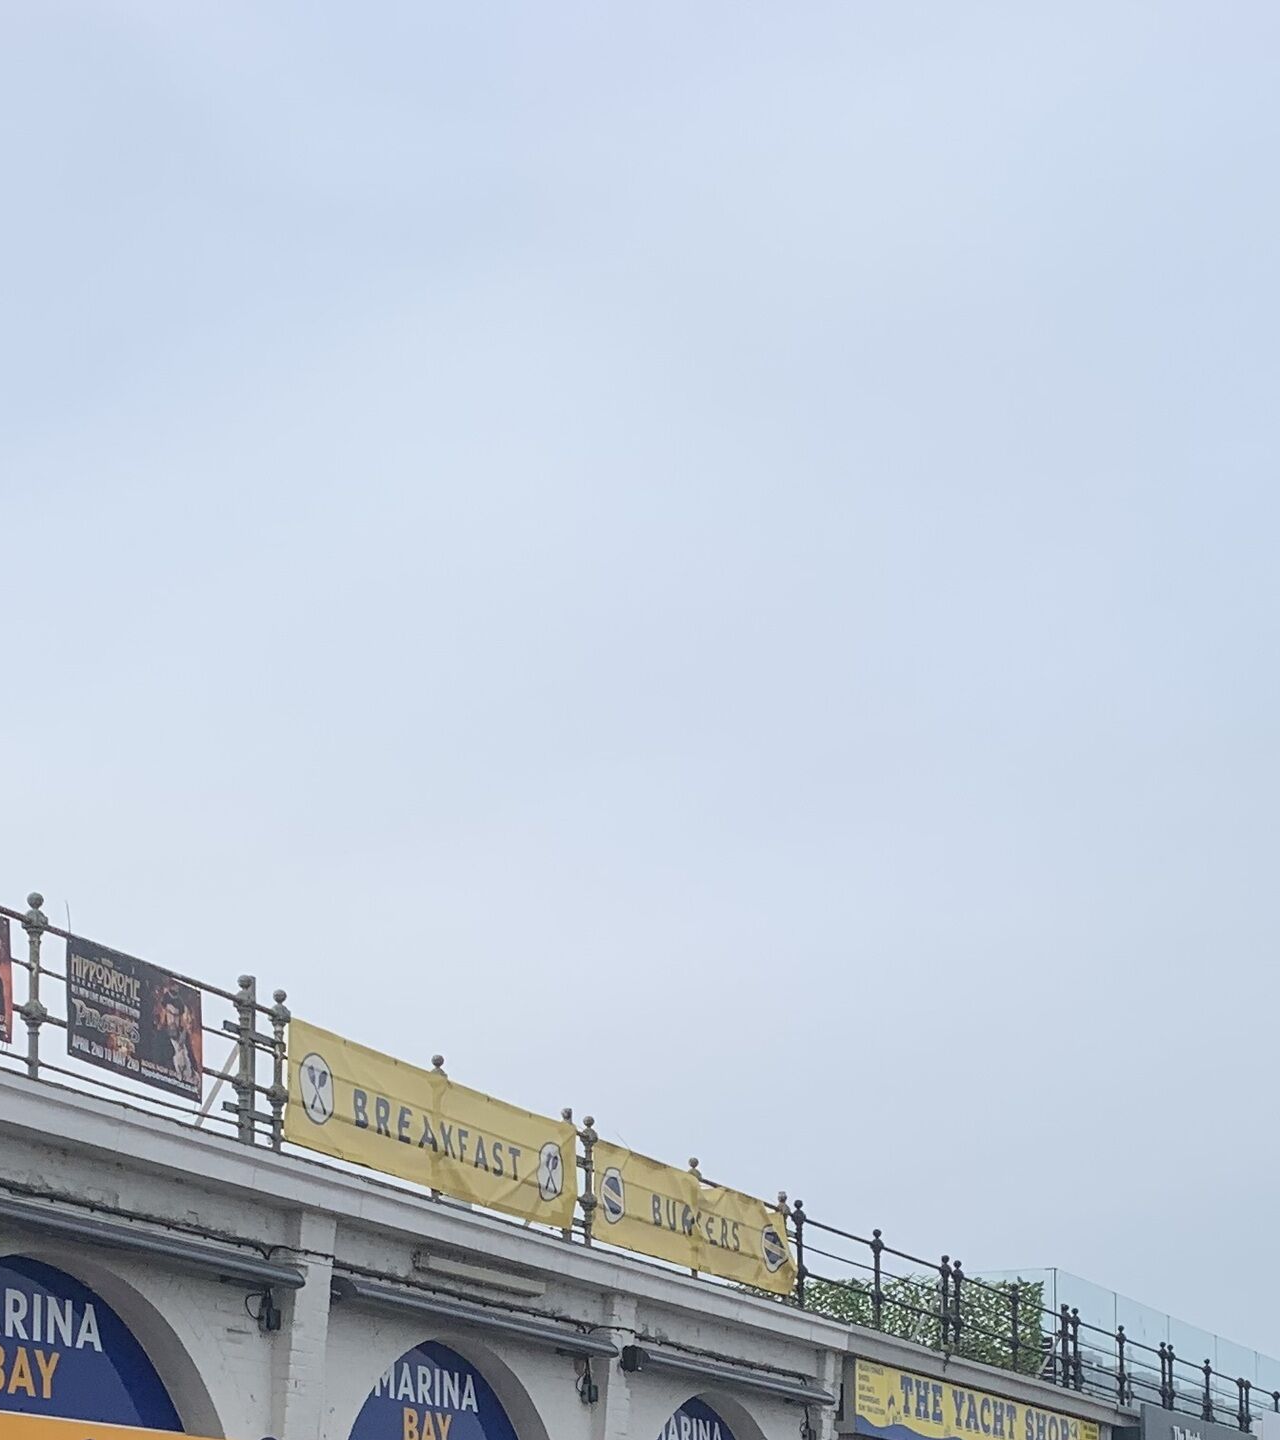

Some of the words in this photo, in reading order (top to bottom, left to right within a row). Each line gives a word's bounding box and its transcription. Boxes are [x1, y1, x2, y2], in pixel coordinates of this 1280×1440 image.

[71, 953, 141, 1002] HIPPODROME
[353, 1087, 521, 1181] BREAKFAST
[375, 1361, 479, 1414] MARINA
[900, 1375, 943, 1421] THE
[952, 1389, 1017, 1440] YACHT
